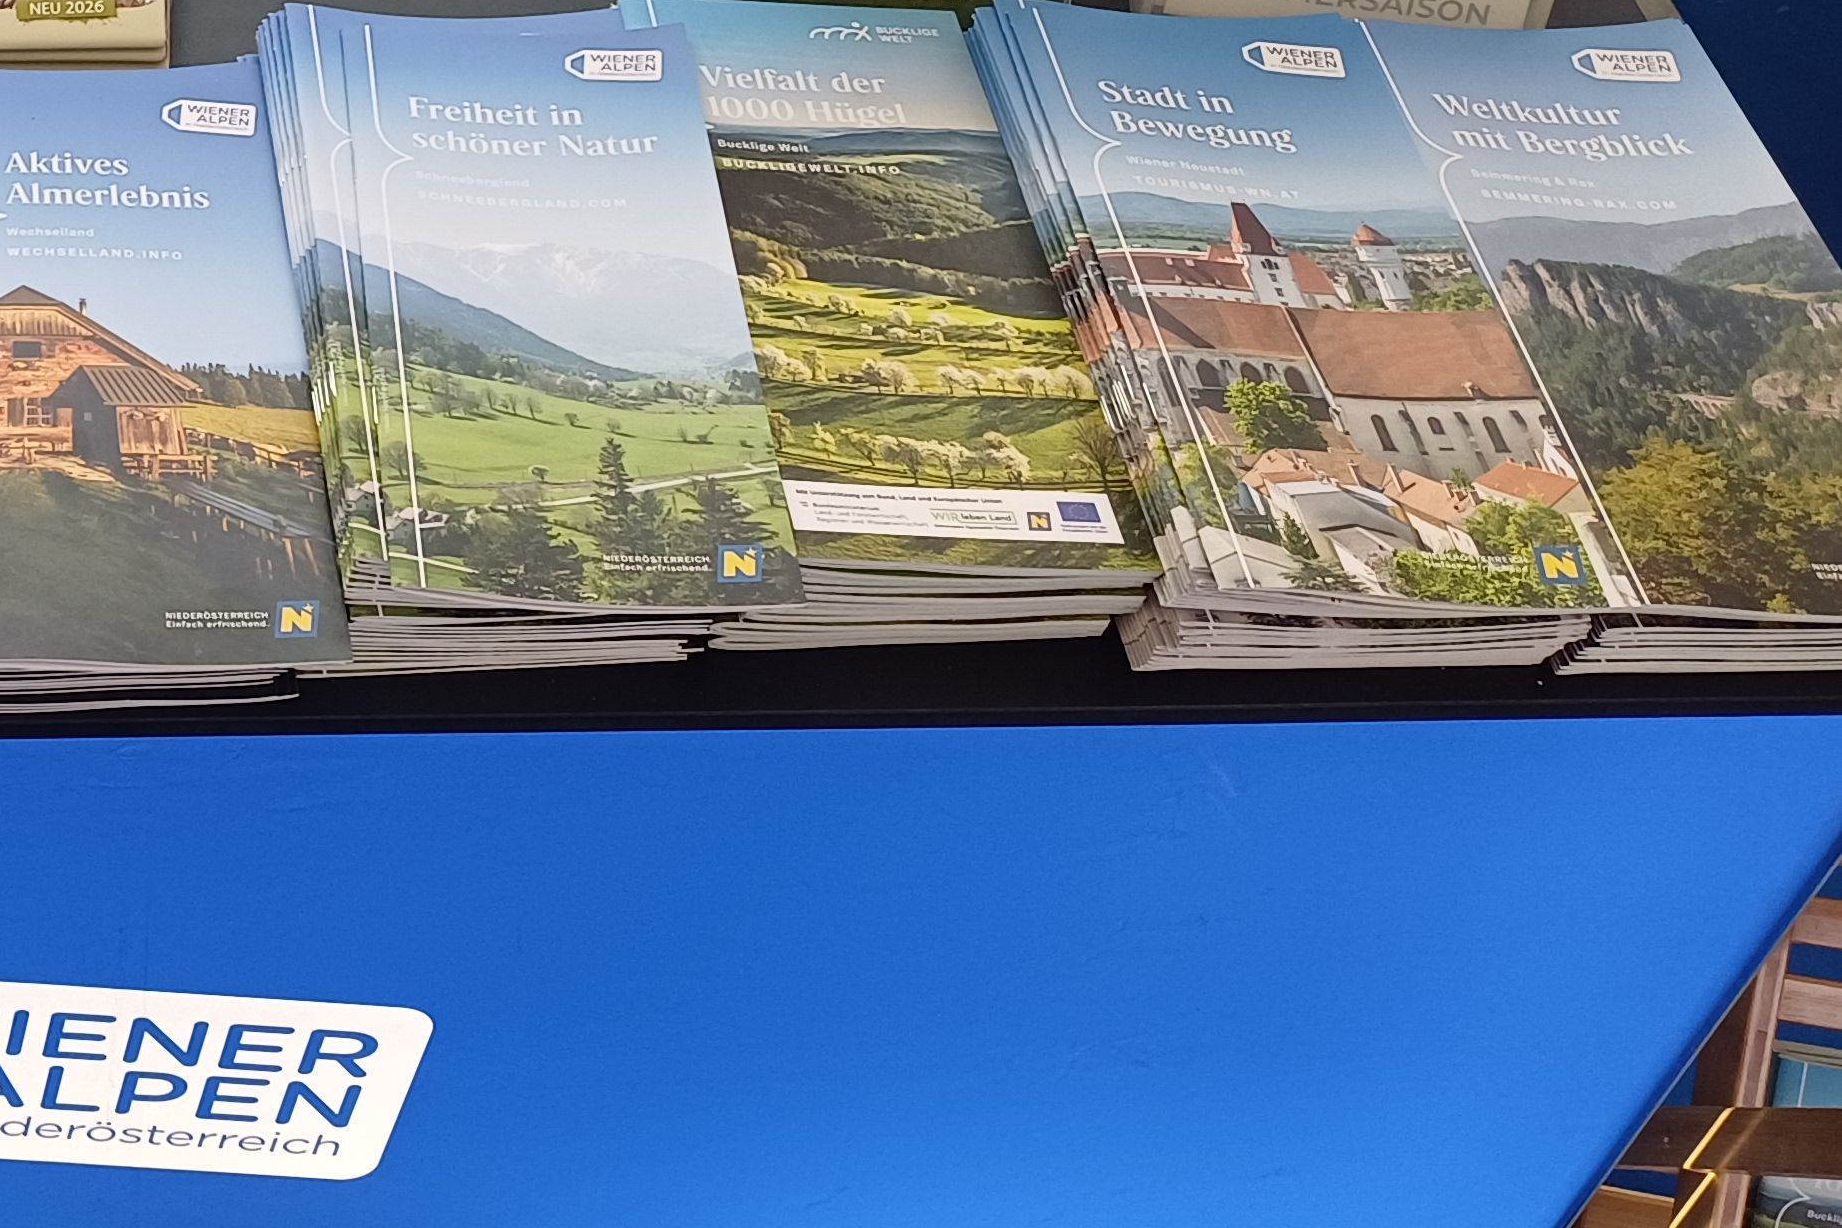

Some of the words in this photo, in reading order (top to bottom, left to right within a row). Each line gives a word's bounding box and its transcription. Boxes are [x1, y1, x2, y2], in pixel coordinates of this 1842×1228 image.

[28, 0, 62, 16] NEU
[64, 0, 105, 15] 2026
[875, 25, 940, 38] BUCKLIGE
[878, 34, 913, 44] WELT
[590, 53, 656, 64] WIENER
[1266, 45, 1334, 60] WIENER
[1596, 53, 1667, 64] WIENER
[601, 62, 656, 72] ALPEN
[1281, 56, 1338, 69] ALPEN
[1613, 62, 1671, 73] ALPEN
[699, 65, 819, 92] Vielfalt
[831, 72, 886, 94] der
[1098, 80, 1190, 110] Stadt
[1198, 90, 1234, 114] in
[187, 104, 250, 118] WIENER
[408, 95, 545, 127] Freiheit
[549, 104, 583, 127] in
[707, 95, 795, 121] 1000
[807, 99, 907, 126] Hügel
[1431, 93, 1621, 126] Weltkultur
[197, 114, 250, 127] ALPEN
[1109, 110, 1298, 154] Bewegung
[412, 131, 547, 157] schöner
[559, 133, 658, 157] Natur
[718, 138, 774, 153] Bucklige
[778, 142, 810, 153] Welt
[1452, 128, 1511, 151] mit
[1516, 130, 1694, 162] Bergblick
[5, 152, 129, 176] Aktives
[722, 157, 901, 175] BUCKLIGEWELT.INFO
[5, 182, 210, 209] Almerlebnis
[6, 226, 95, 238] Wechselland
[6, 247, 183, 261] WECHSELLAND.INFO
[724, 551, 756, 577] N
[280, 607, 312, 633] N
